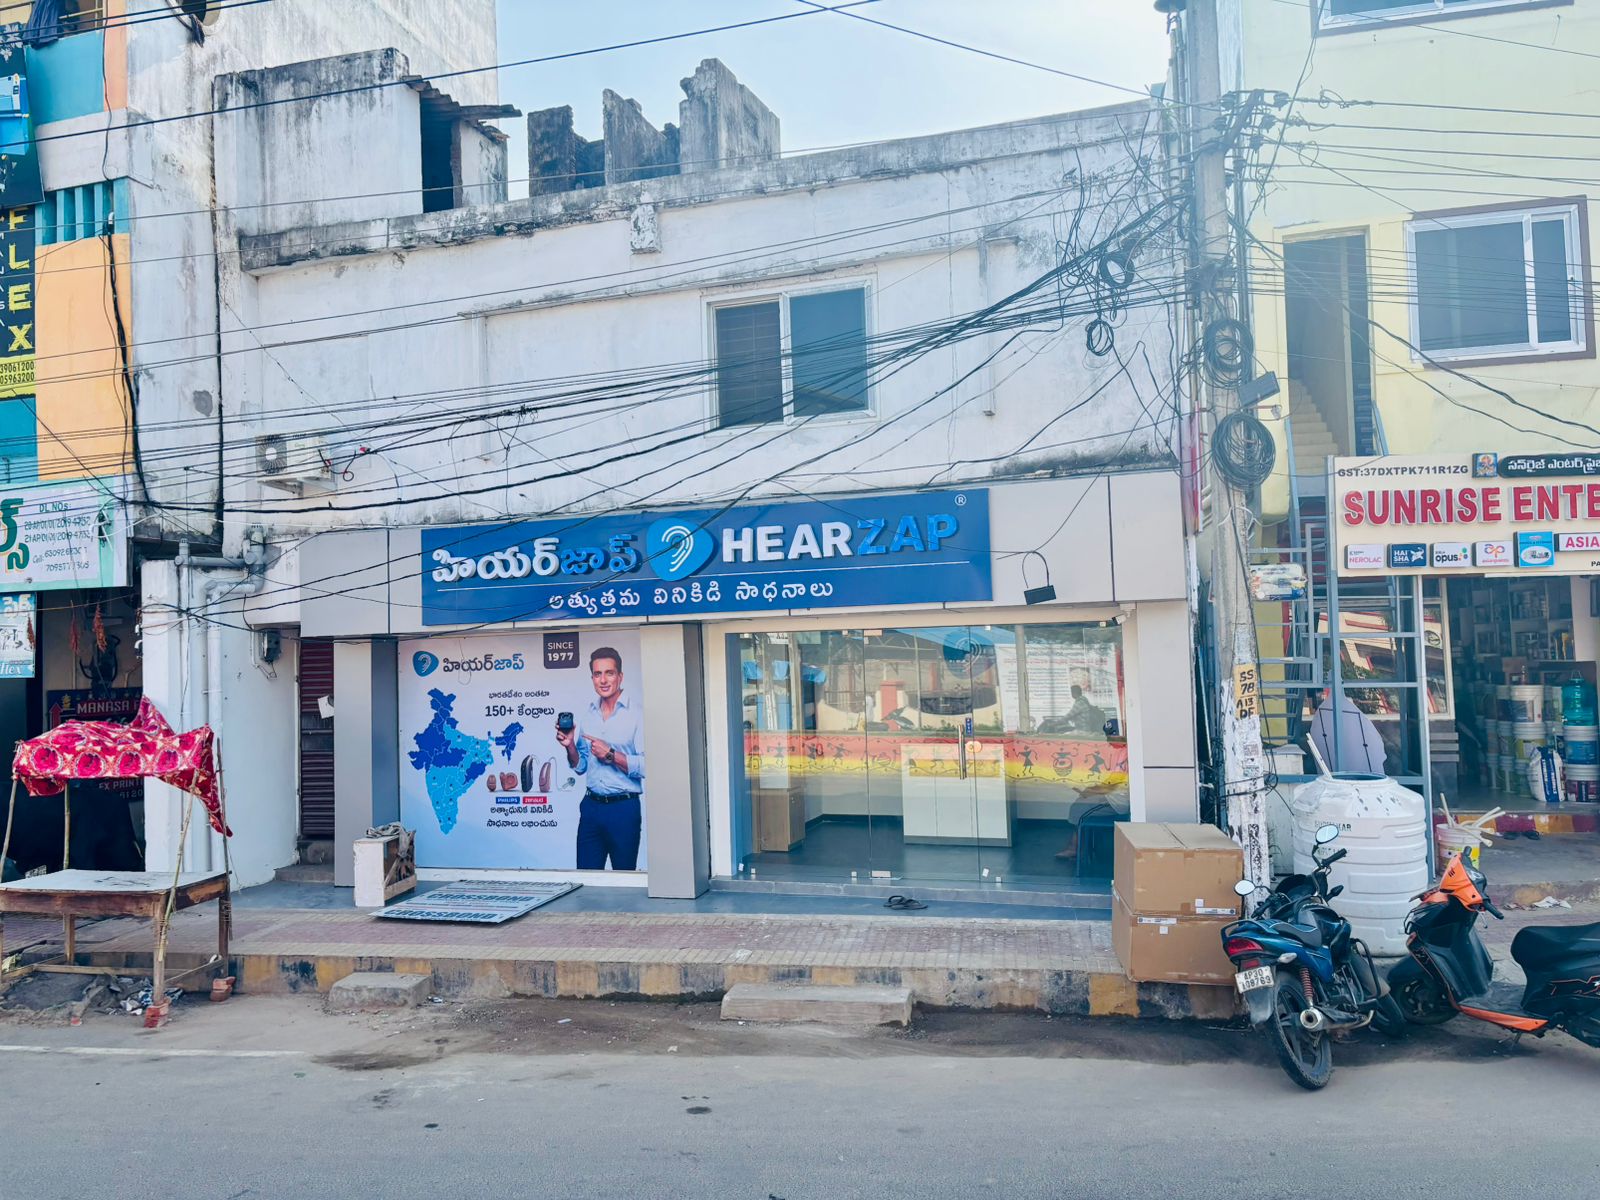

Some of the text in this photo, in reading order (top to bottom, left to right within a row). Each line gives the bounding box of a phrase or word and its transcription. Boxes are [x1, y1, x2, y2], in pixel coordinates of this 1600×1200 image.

[8, 207, 34, 352] FLEX
[1343, 482, 1600, 526] SUNRISE ENTE
[722, 512, 959, 563] HEARZAP
[1565, 536, 1600, 548] ASIA
[549, 580, 834, 615] అత్యుత్తమ వినికిడి సాధనాలు
[547, 641, 574, 650] SINCE
[547, 652, 574, 661] 1977
[1239, 669, 1254, 682] SS
[1240, 682, 1255, 696] 78
[77, 700, 129, 714] MANASA
[485, 703, 555, 719] 150+ కేంద్రాలు
[486, 818, 519, 828] సాధనాలు
[426, 893, 535, 902] CROSSBOND
[383, 909, 499, 920] CROSSBOND
